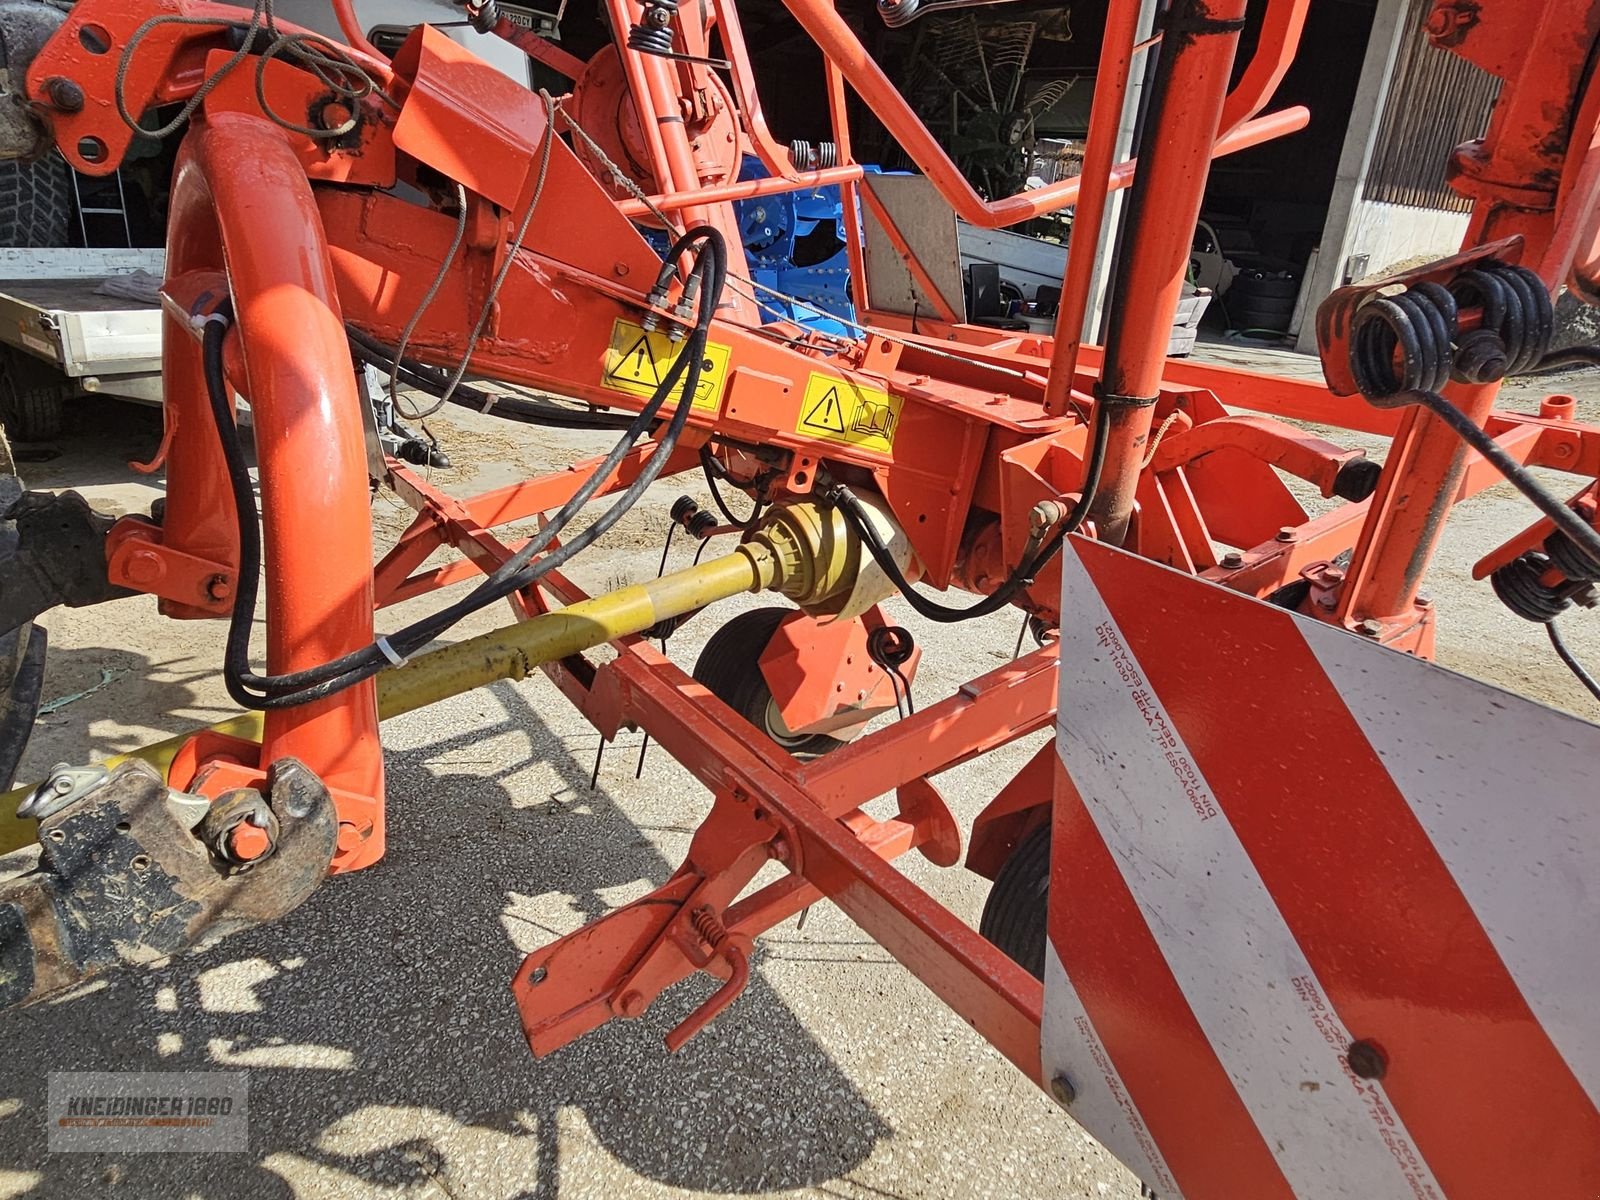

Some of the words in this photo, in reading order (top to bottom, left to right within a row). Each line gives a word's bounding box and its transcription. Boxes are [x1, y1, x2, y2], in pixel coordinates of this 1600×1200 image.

[1095, 626, 1110, 646] DIN
[1108, 650, 1129, 682] 11030
[1131, 690, 1154, 726] GEKA
[1156, 734, 1167, 750] TP
[1153, 712, 1176, 748] GEKA
[1178, 756, 1200, 790] 11030
[1199, 794, 1216, 818] DIN
[1291, 976, 1309, 1001] DIN
[1306, 1005, 1333, 1043] 11030
[1299, 974, 1325, 1012] 06021
[1366, 1084, 1394, 1126] GEKA
